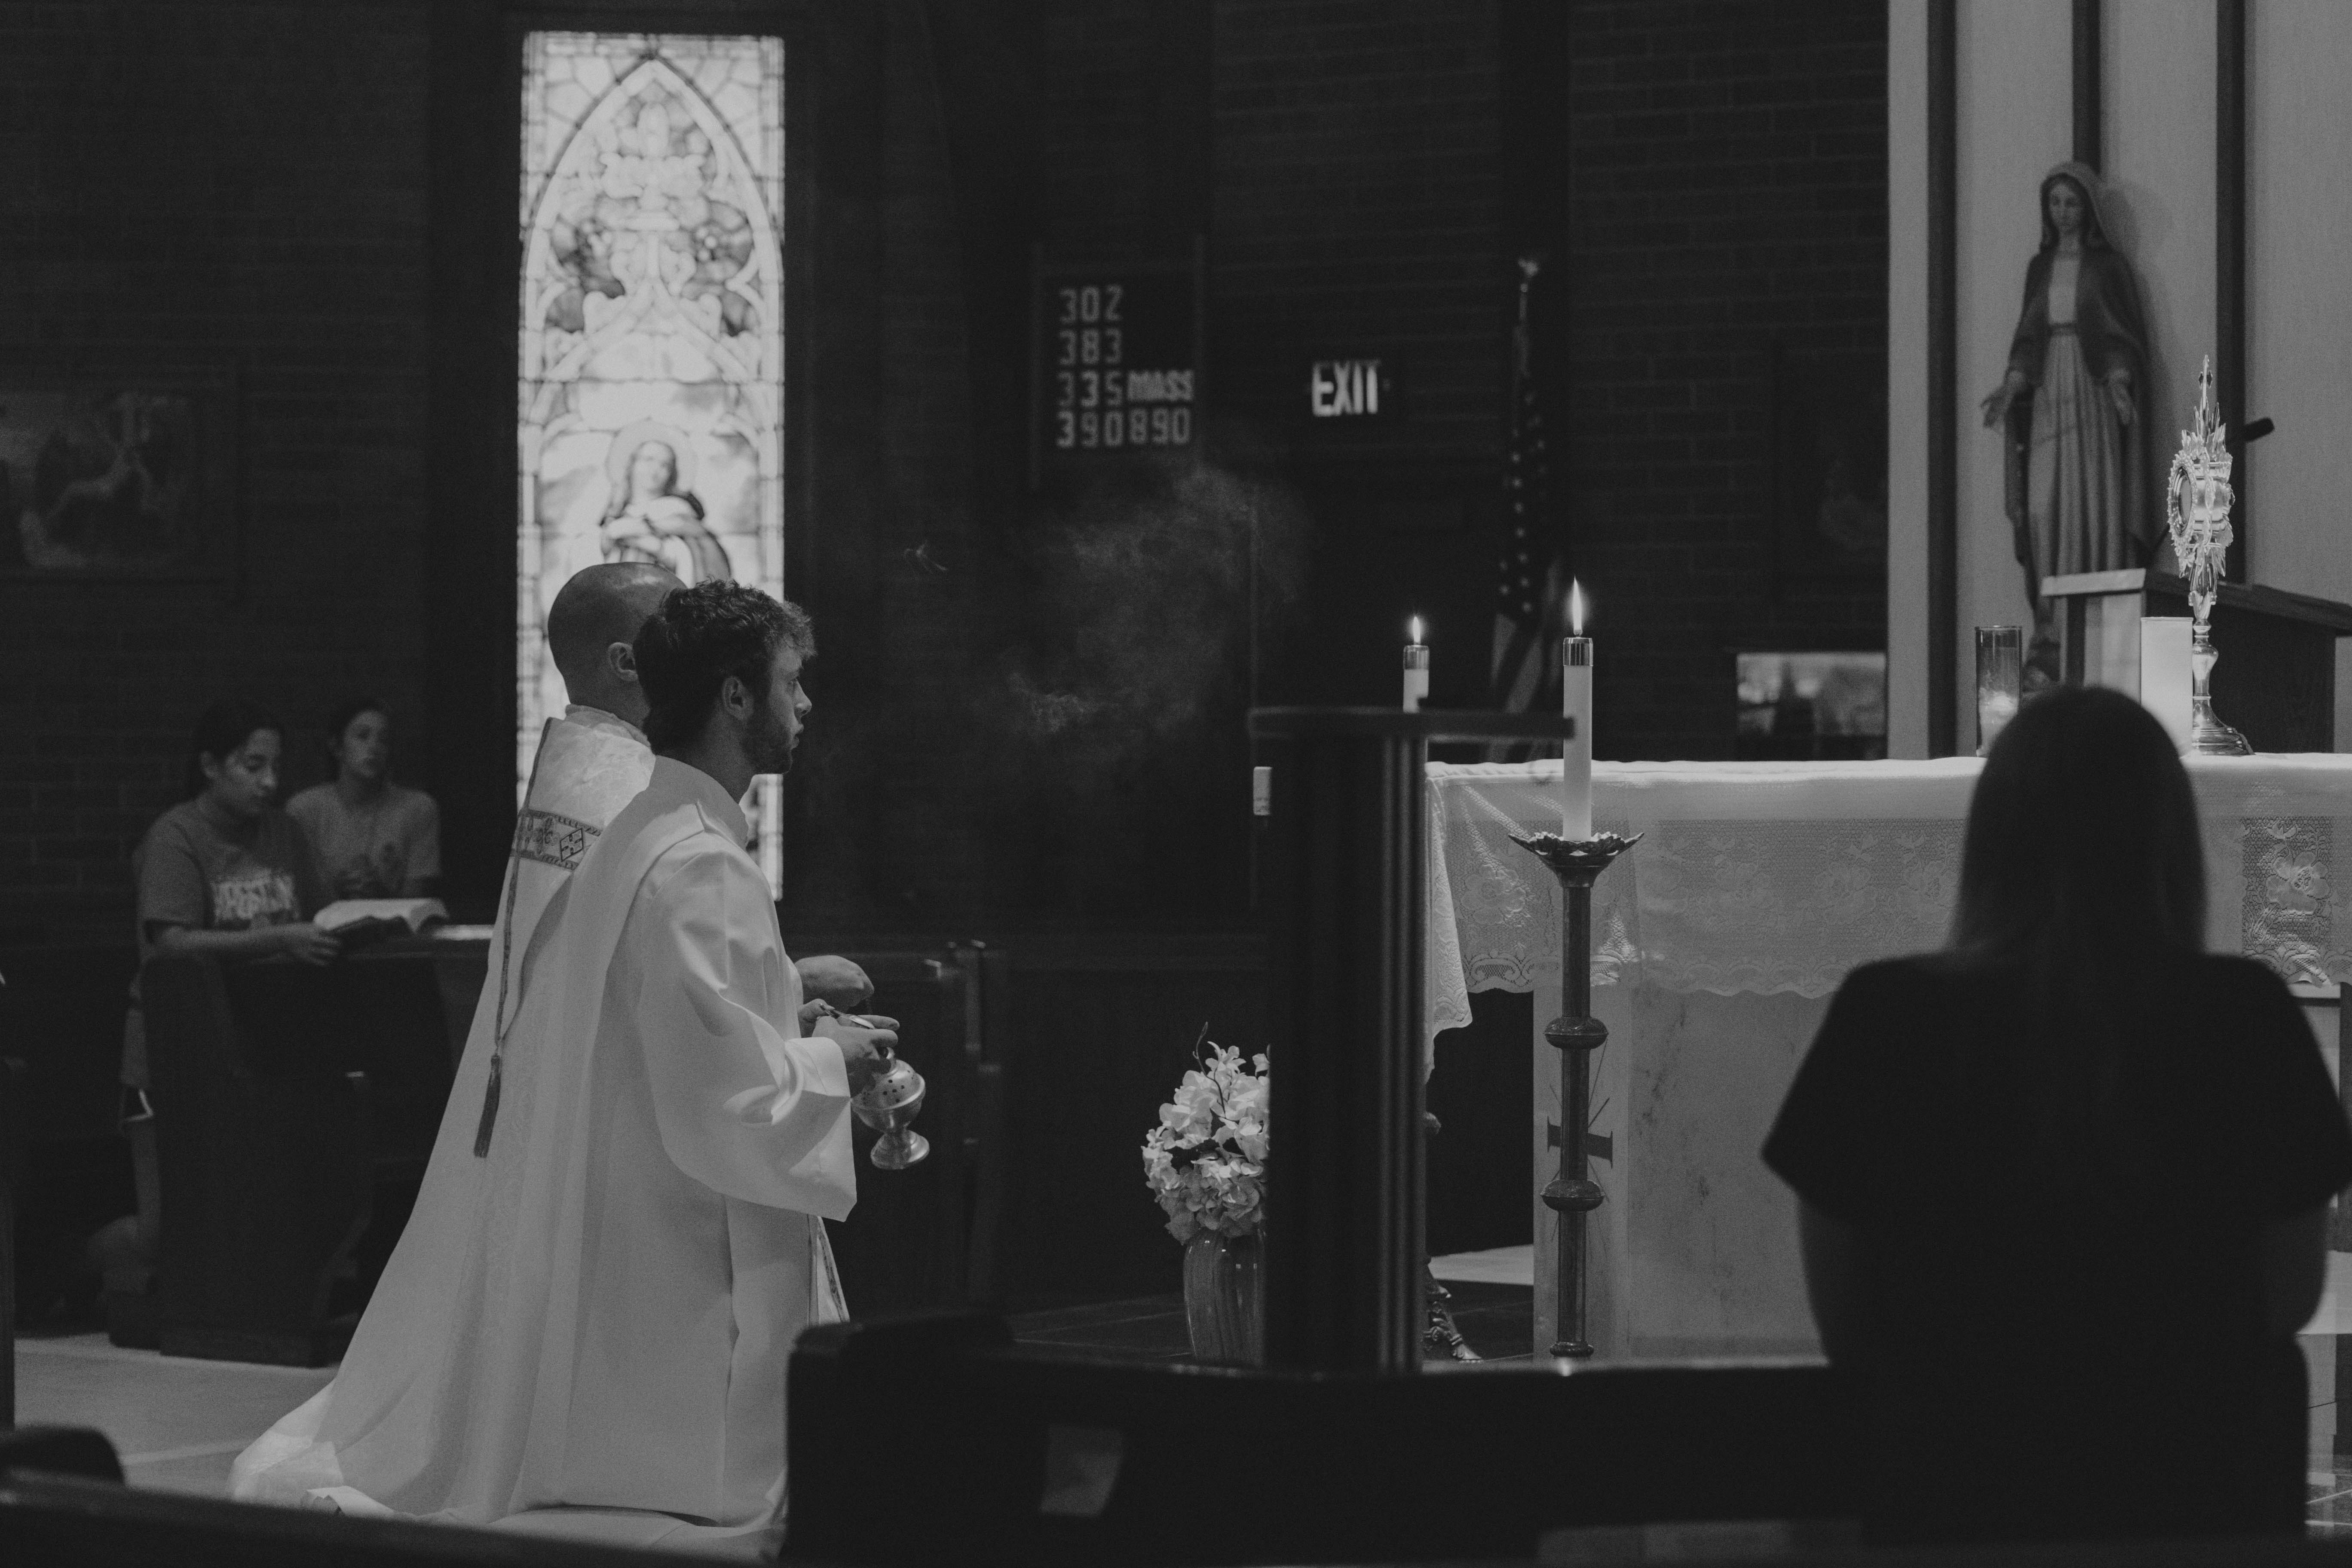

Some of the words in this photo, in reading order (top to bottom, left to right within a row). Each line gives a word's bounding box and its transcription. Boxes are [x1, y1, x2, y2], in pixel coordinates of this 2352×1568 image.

[1060, 285, 1123, 323] 302
[1059, 328, 1122, 365] 383
[1057, 370, 1122, 407] 335
[1311, 360, 1380, 417] EXIT
